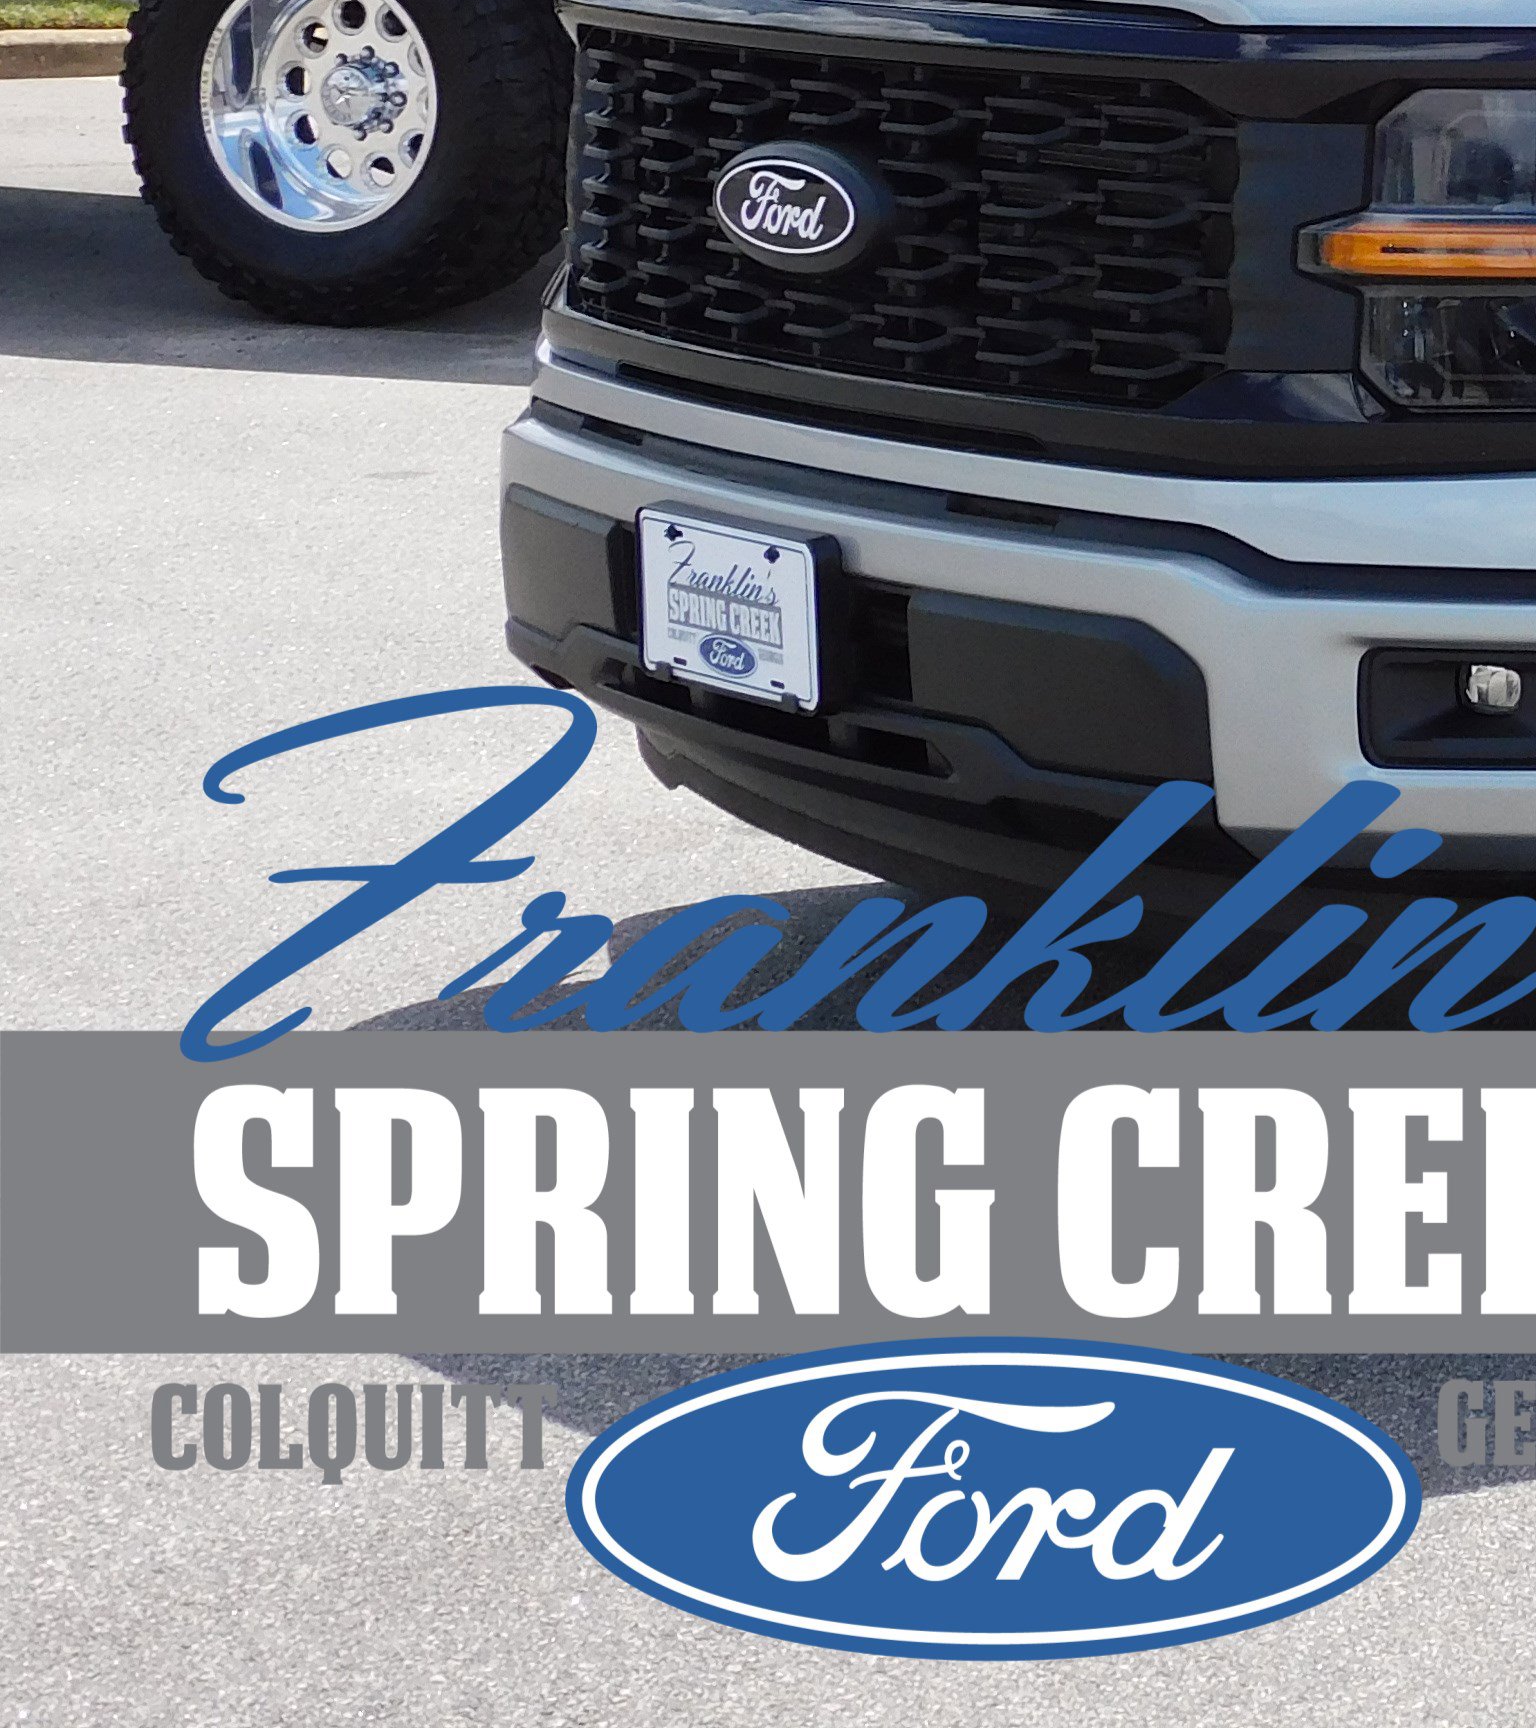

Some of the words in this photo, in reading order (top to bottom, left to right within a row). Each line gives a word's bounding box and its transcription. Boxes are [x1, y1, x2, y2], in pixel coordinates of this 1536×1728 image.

[740, 170, 827, 241] Ford
[668, 540, 779, 606] Franklin's
[669, 589, 728, 632] SPRING
[729, 602, 782, 646] CREEK
[709, 638, 746, 671] Ford
